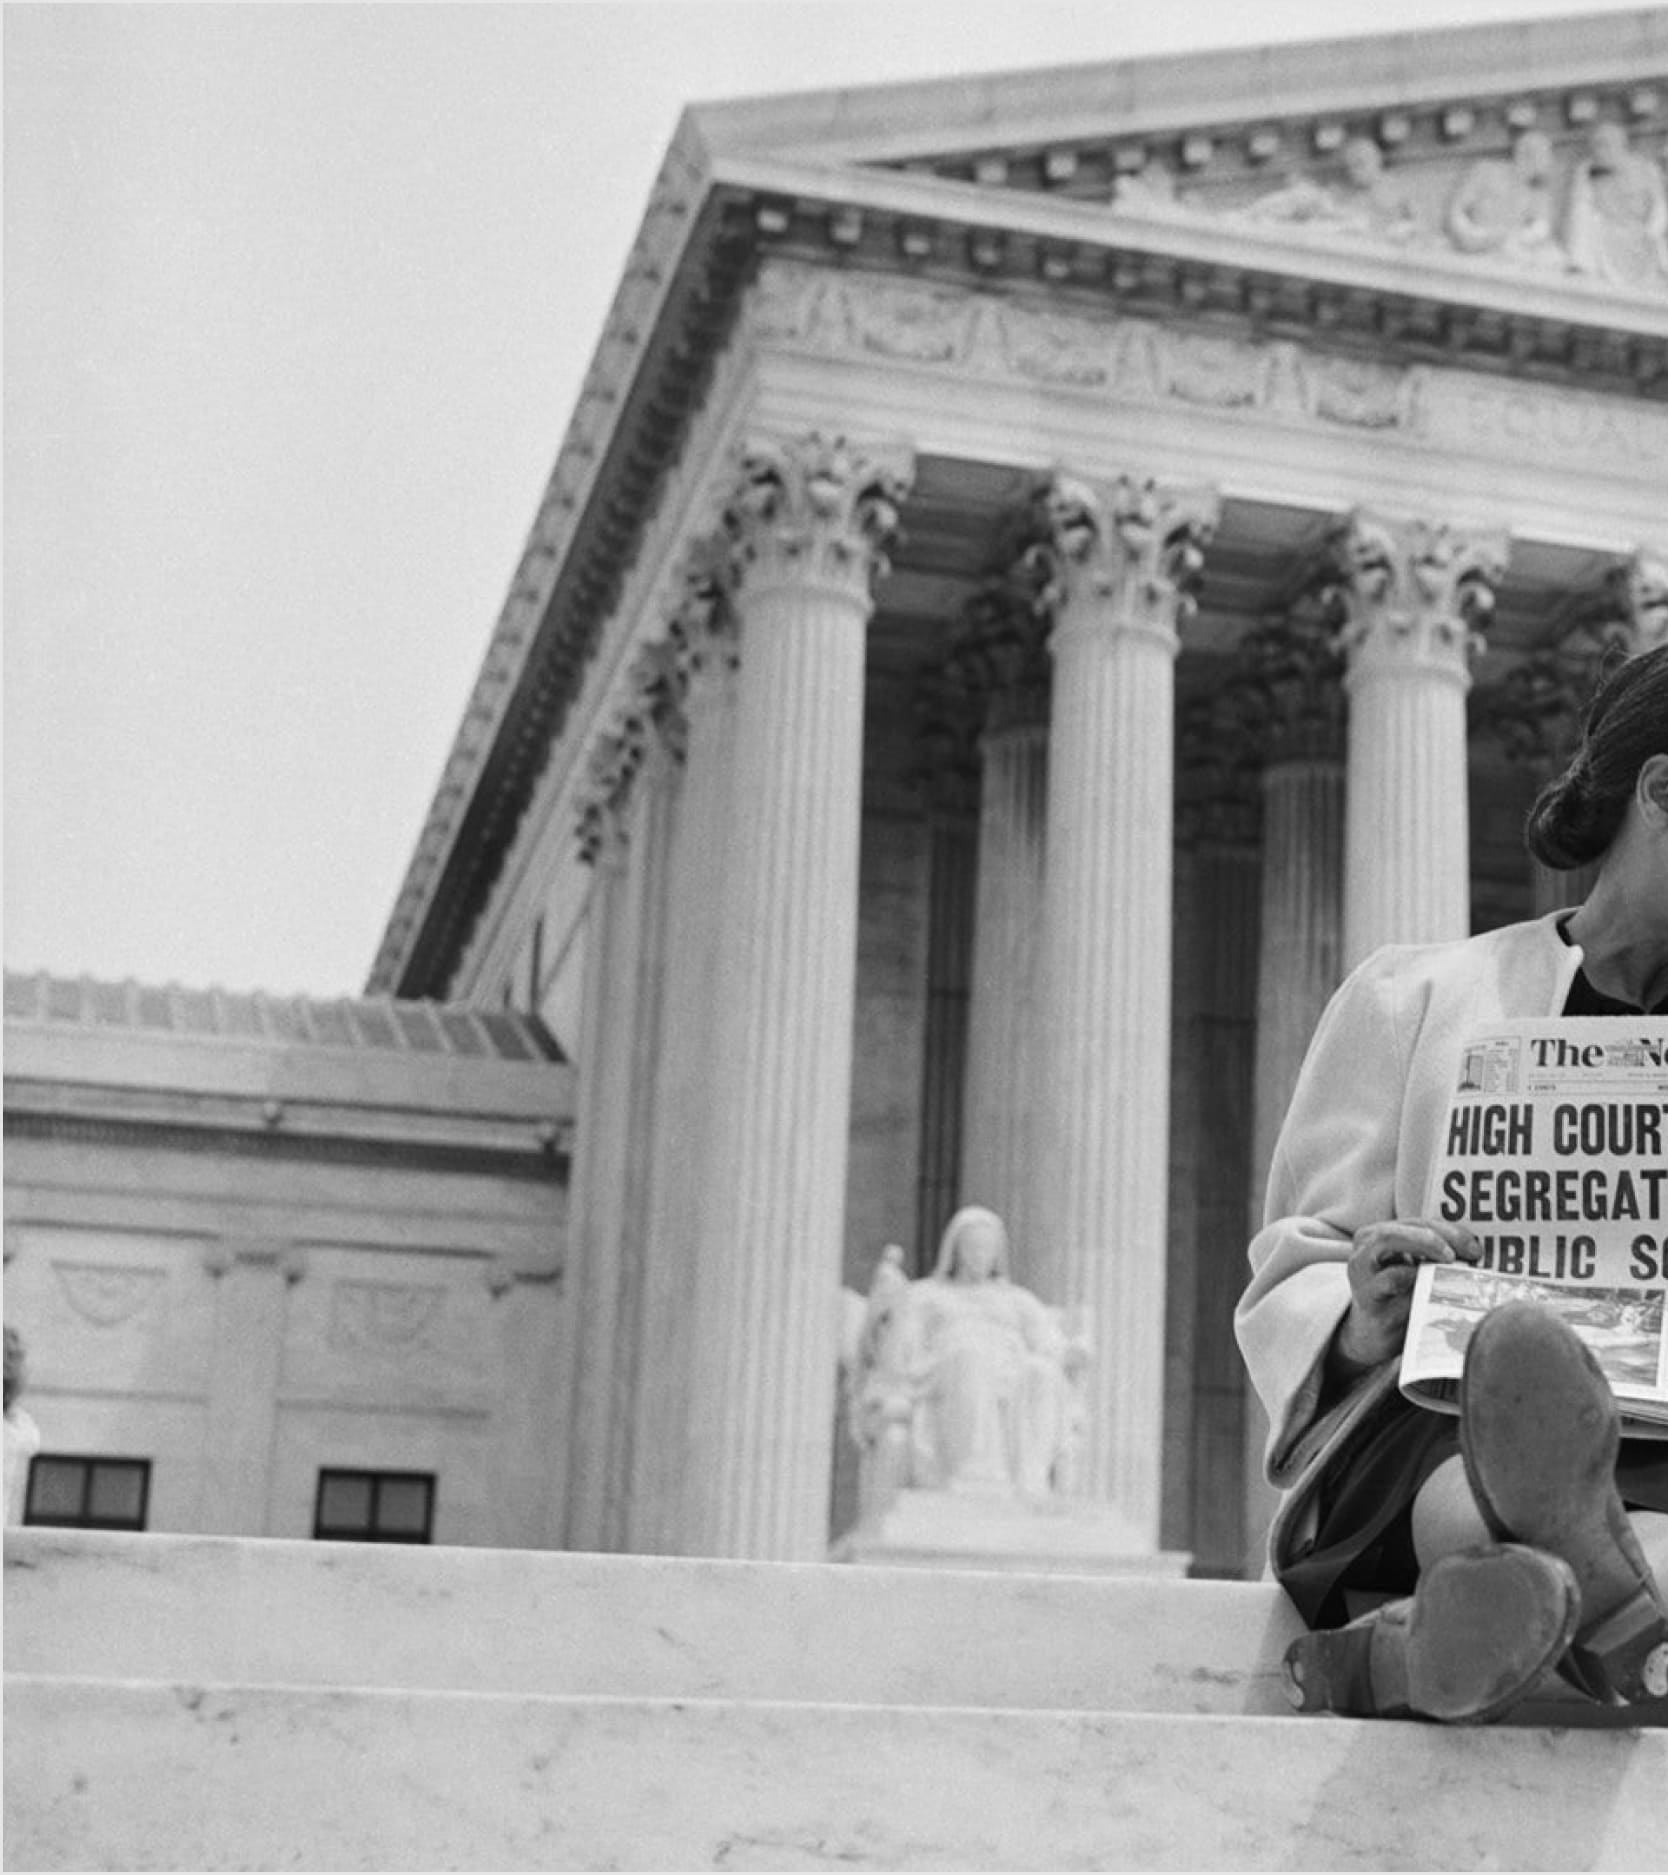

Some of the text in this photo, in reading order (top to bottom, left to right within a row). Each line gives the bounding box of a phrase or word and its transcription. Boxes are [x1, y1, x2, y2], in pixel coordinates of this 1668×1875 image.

[1468, 392, 1661, 461] EQUAL
[1530, 1038, 1604, 1068] The
[1447, 1103, 1533, 1156] HIGH
